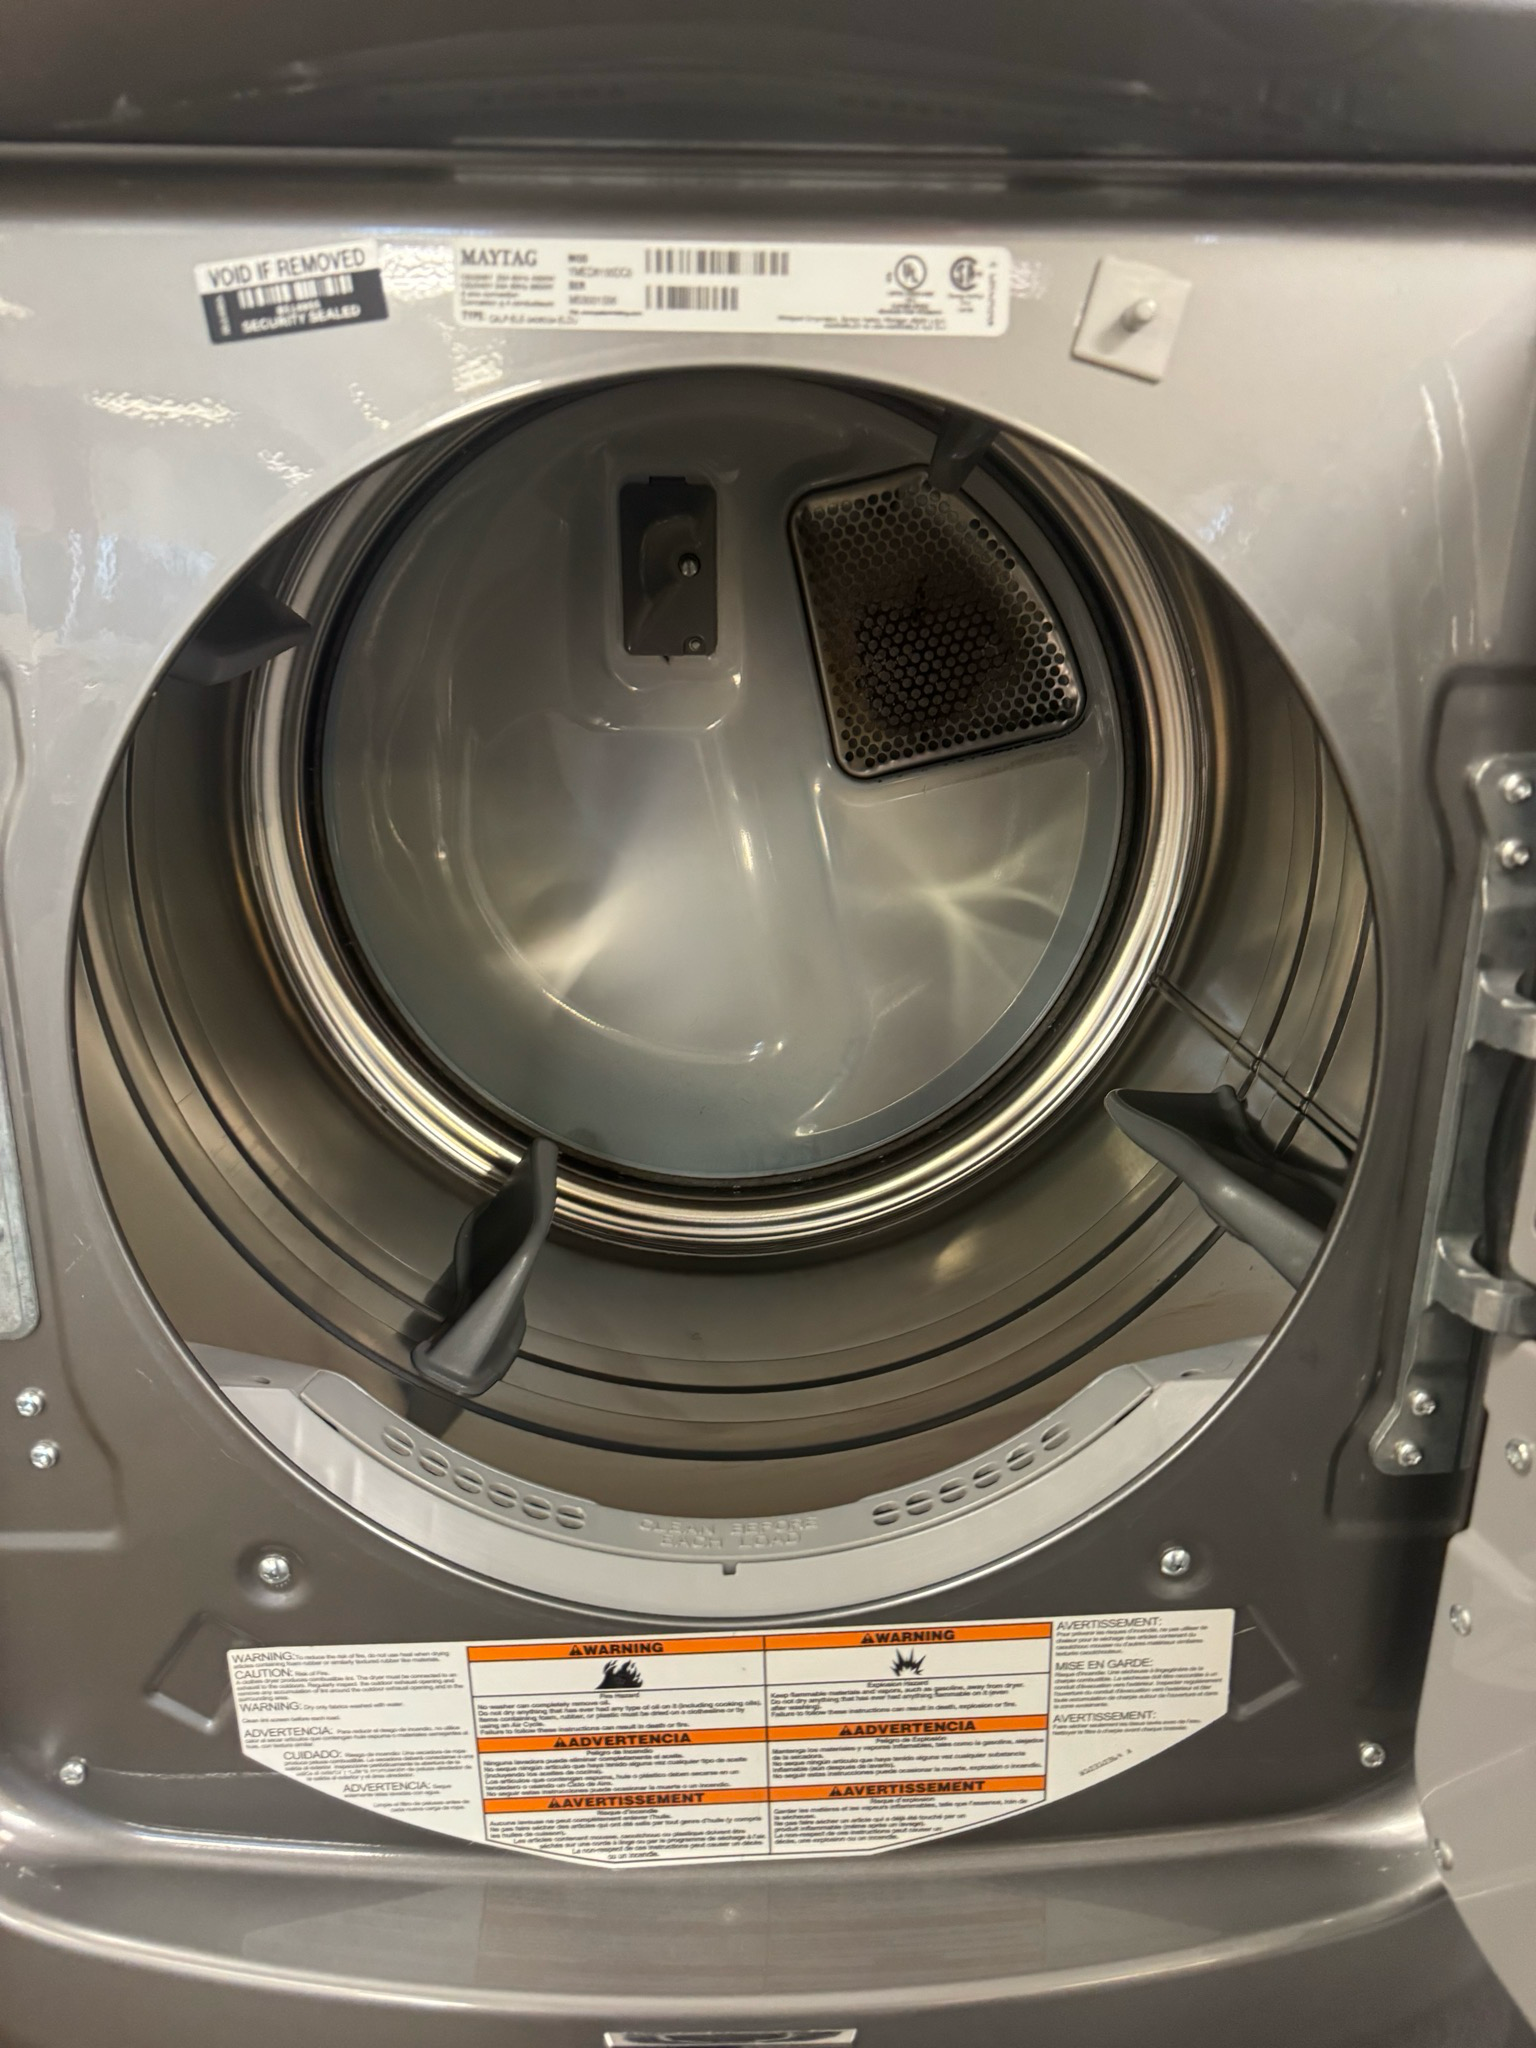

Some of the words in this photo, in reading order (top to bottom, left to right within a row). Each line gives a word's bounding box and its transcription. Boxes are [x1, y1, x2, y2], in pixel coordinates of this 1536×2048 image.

[461, 248, 537, 267] MAYTAG
[208, 265, 252, 288] VOID
[257, 261, 271, 280] IF
[277, 247, 365, 277] REMOVED
[241, 313, 307, 335] SECURITY
[308, 304, 362, 324] SEALED
[638, 1518, 715, 1536] CLEAN
[730, 1516, 818, 1536] BEFORE
[660, 1534, 723, 1549] EACH
[738, 1531, 802, 1549] LOAD
[1056, 1616, 1162, 1630] AVERTISSEMENT:
[875, 1630, 955, 1643] WARNING
[583, 1642, 664, 1655] WARNING
[231, 1651, 295, 1663] WARNING:
[1055, 1659, 1085, 1670] MISE
[1087, 1659, 1104, 1669] EN
[1107, 1658, 1153, 1668] GARDE:
[235, 1668, 293, 1680] CAUTION:
[239, 1701, 302, 1712] WARNING:
[1053, 1710, 1157, 1723] AVERTISSEMENT:
[244, 1726, 333, 1738] ADVERTENCIA:
[853, 1720, 976, 1735] ADVERTENCIA
[569, 1733, 691, 1747] ADVERTENCIA
[283, 1750, 342, 1760] CUIDADO:
[343, 1782, 431, 1793] ADVERTENCIA:
[842, 1781, 985, 1797] AVERTISSEMENT
[562, 1793, 705, 1808] AVERTISSEMENT
